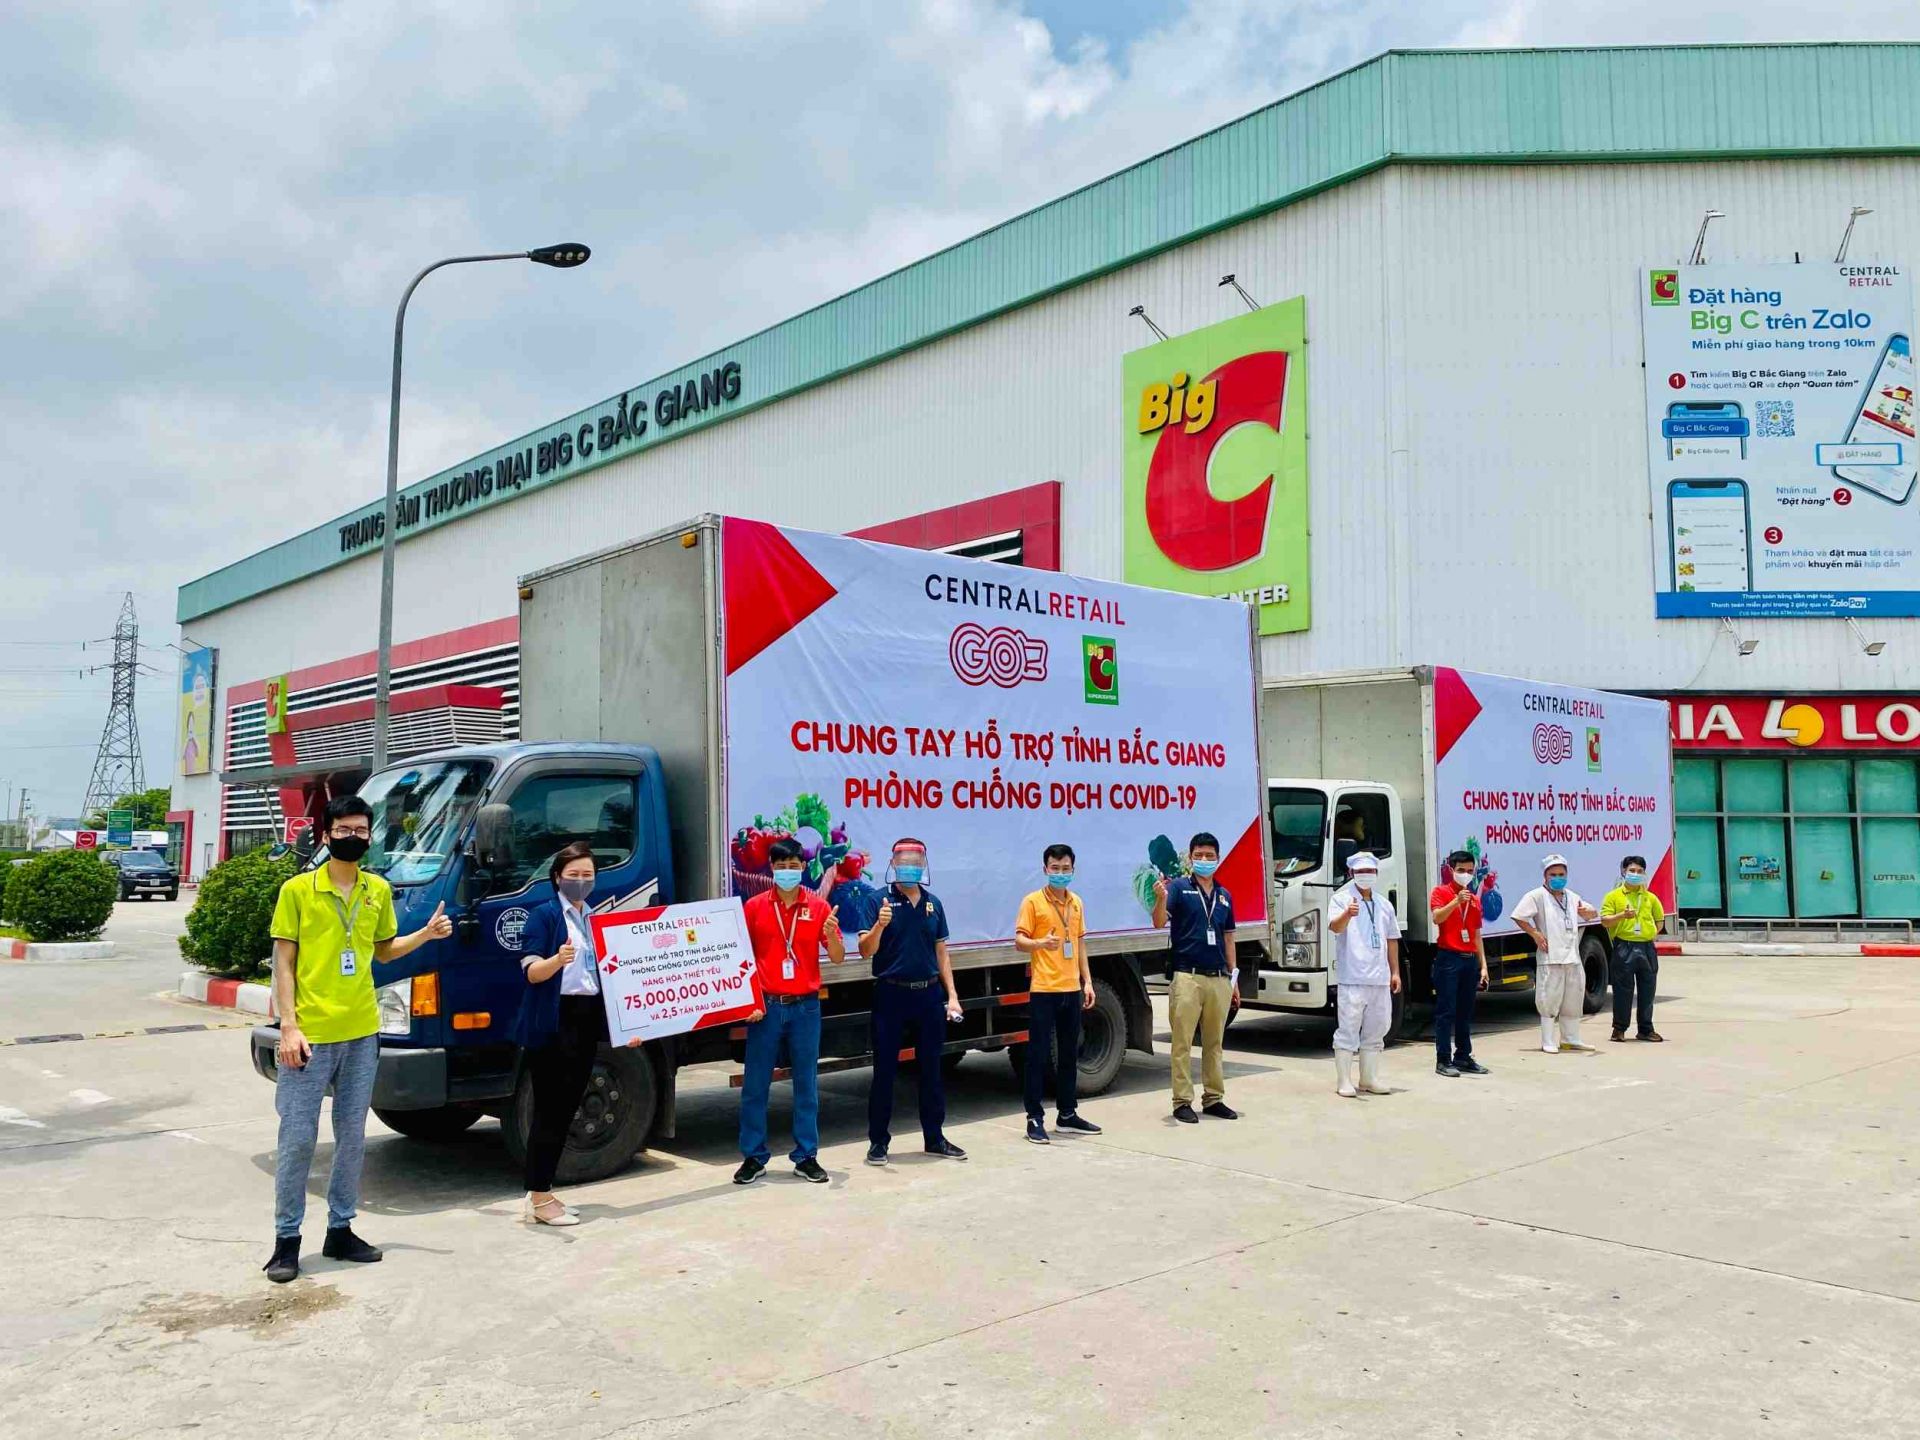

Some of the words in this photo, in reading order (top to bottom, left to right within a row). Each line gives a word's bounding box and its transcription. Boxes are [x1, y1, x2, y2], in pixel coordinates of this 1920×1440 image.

[1839, 266, 1900, 276] CENTRAL
[1849, 277, 1892, 286] RETAIL
[1688, 288, 1726, 308] Đặt
[1730, 287, 1782, 307] hàng
[1690, 309, 1732, 335] Big
[1739, 309, 1760, 330] C
[1765, 312, 1807, 330] trên
[1811, 308, 1872, 330] Zalo
[1724, 339, 1744, 351] phí
[1746, 339, 1772, 351] giao
[1808, 339, 1841, 350] trong
[1843, 338, 1876, 348] 10km
[1732, 370, 1748, 379] Big
[1749, 370, 1757, 378] C
[1759, 368, 1777, 378] Bắc
[1778, 369, 1806, 379] Giang
[1826, 369, 1847, 377] Zalo
[1748, 381, 1763, 389] QR
[1777, 380, 1800, 390] chọn
[1139, 371, 1219, 435] Big
[1673, 425, 1685, 433] Big
[1708, 424, 1730, 433] Giang
[338, 511, 385, 552] TRUNG
[395, 494, 421, 530] ÂM
[423, 465, 493, 519] THƯƠNG
[496, 447, 532, 490] MẠI
[536, 432, 573, 475] BIG
[576, 423, 594, 458] C
[597, 393, 648, 451] BẮC
[654, 360, 741, 427] GIANG
[1144, 350, 1292, 572] C
[1837, 491, 1848, 503] 2
[1768, 529, 1779, 541] 3
[1765, 549, 1790, 557] Tham
[1829, 548, 1845, 559] đặt
[791, 720, 898, 756] CHUNG
[904, 727, 956, 758] TAY
[965, 718, 1002, 760] HỖ
[1009, 731, 1054, 768] TRỢ
[1061, 726, 1112, 764] TỈNH
[1118, 727, 1160, 766] BẮC
[1165, 741, 1226, 768] GIANG
[844, 770, 943, 809] PHÒNG
[951, 766, 1042, 809] CHỐNG
[1049, 782, 1102, 816] DỊCH
[1109, 784, 1197, 810] COVID-19
[1463, 790, 1509, 811] CHUNG
[1512, 791, 1535, 811] TAY
[1538, 785, 1555, 811] HỖ
[1558, 791, 1578, 815] TRỢ
[1580, 786, 1604, 812] TỈNH
[1606, 786, 1626, 813] BẮC
[1628, 795, 1656, 813] GIANG
[1486, 820, 1529, 844] PHÒNG
[1533, 815, 1573, 844] CHỐNG
[1576, 825, 1600, 846] DỊCH
[1602, 825, 1643, 842] COVID-19
[1873, 873, 1916, 882] LOTTERIA
[618, 956, 644, 968] CHUNG
[645, 954, 657, 963] TAY
[716, 941, 738, 951] GIANG
[700, 953, 730, 965] COVID-19
[624, 981, 709, 1011] 75,000,000
[712, 975, 743, 993] VND
[661, 1006, 678, 1020] 2,5
[695, 1003, 710, 1012] RAU
